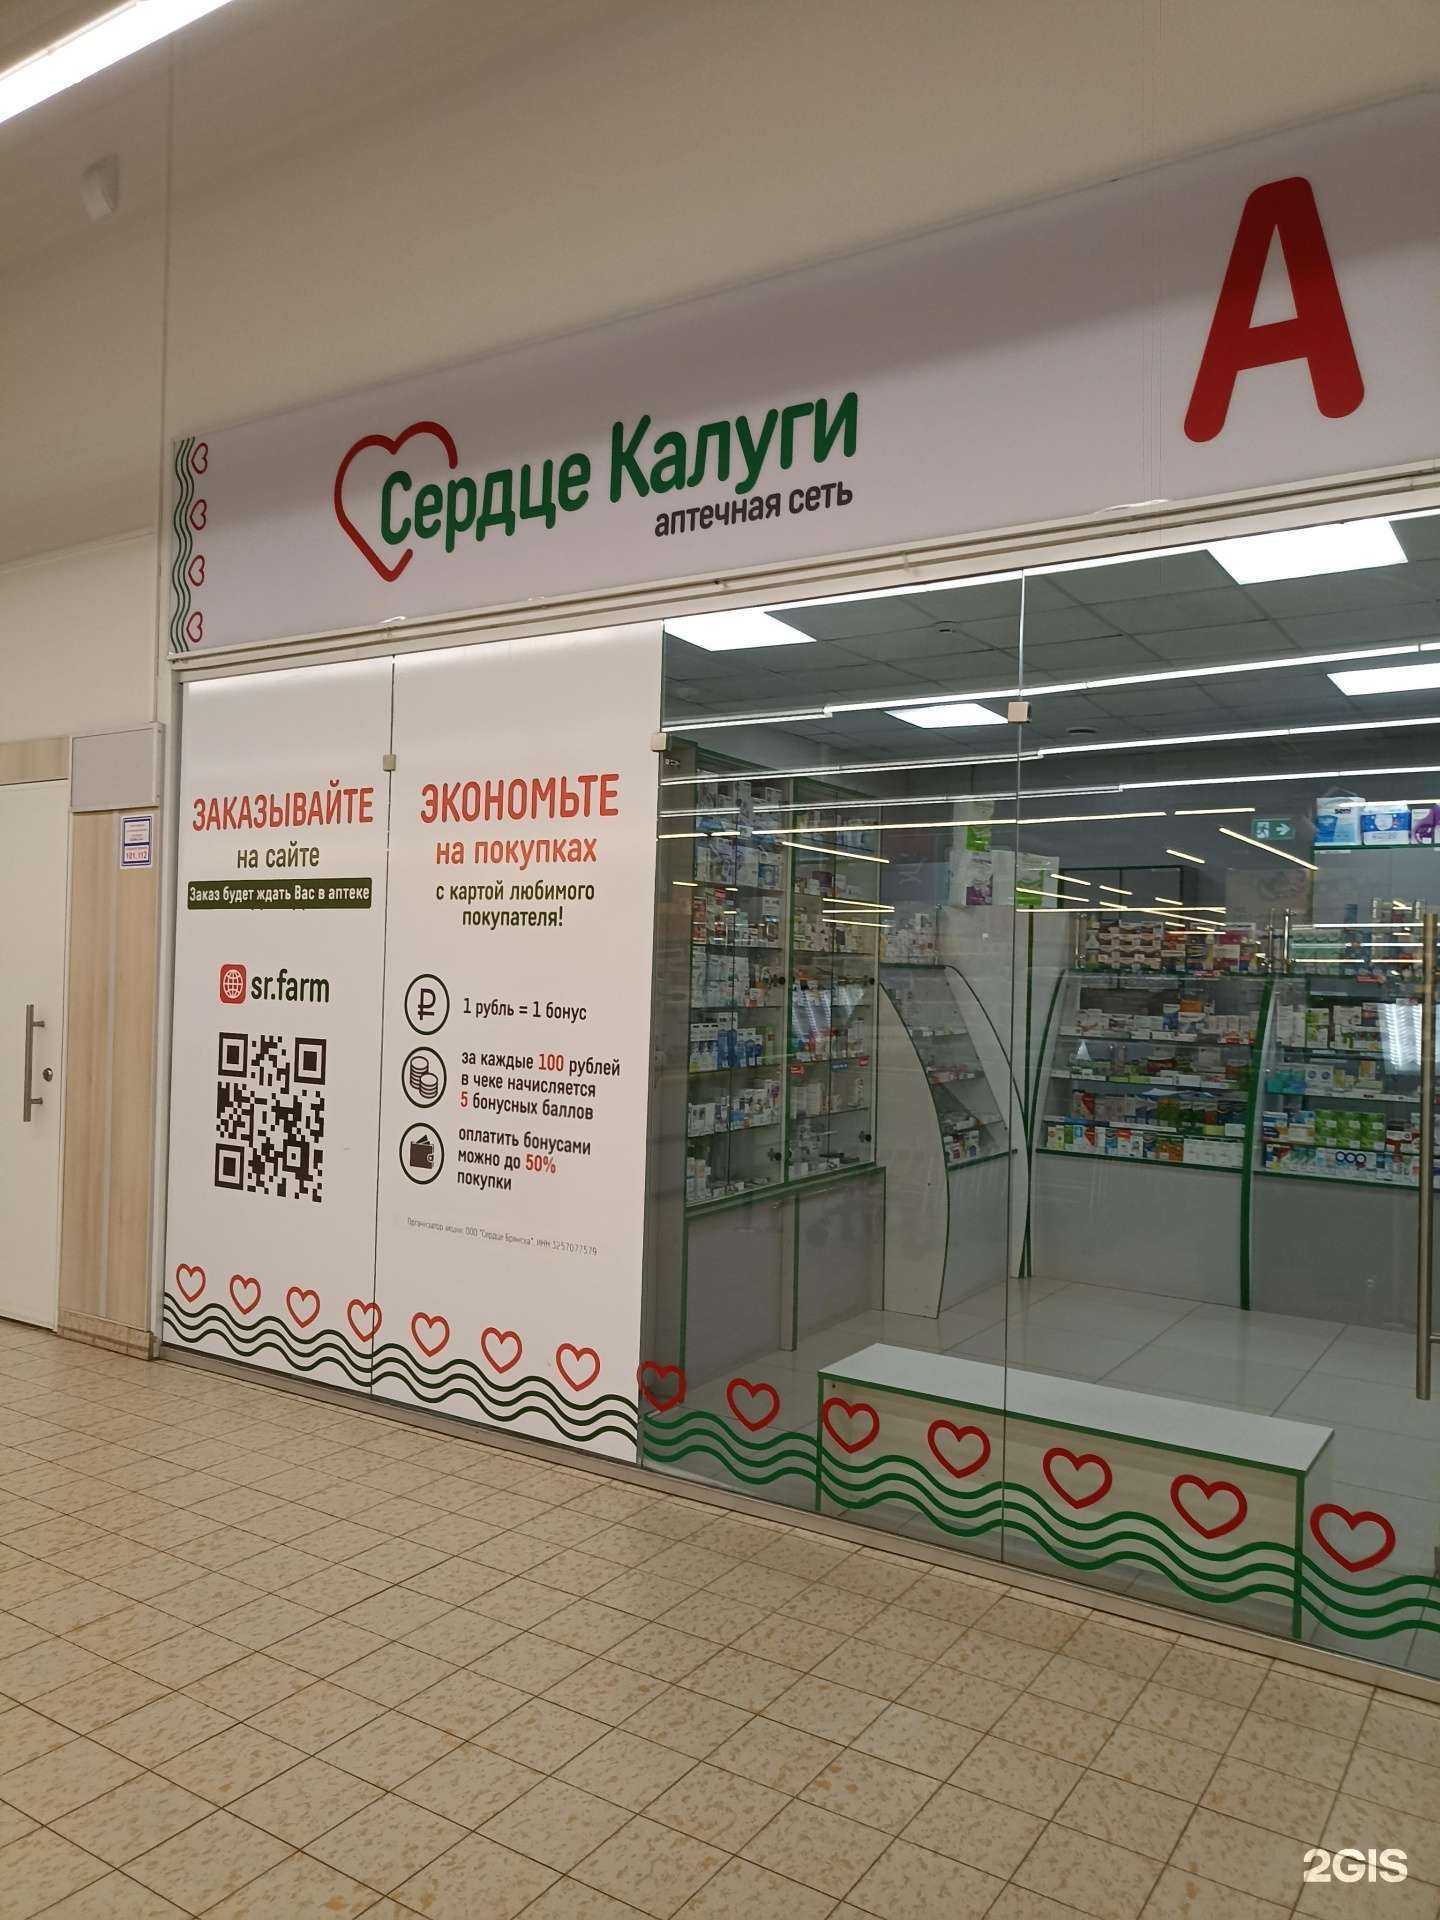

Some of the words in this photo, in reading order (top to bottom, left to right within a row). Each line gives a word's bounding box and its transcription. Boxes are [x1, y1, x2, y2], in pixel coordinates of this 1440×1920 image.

[381, 452, 591, 553] Сердце
[610, 392, 858, 503] Калуги
[654, 491, 781, 537] аптечная
[788, 480, 853, 512] сеть
[192, 779, 374, 832] ЗАКАЗЫВАЙТЕ
[420, 773, 620, 824] ЭКОНОМЬТЕ
[237, 849, 258, 869] на
[265, 840, 320, 868] сайте
[436, 841, 465, 865] на
[474, 838, 598, 871] покупках
[190, 886, 220, 901] Заказ
[222, 886, 254, 903] будет
[256, 888, 291, 902] ждать
[294, 884, 315, 900] Вас
[318, 887, 325, 899] в
[328, 887, 370, 900] аптеке
[436, 885, 445, 900] с
[449, 880, 504, 904] картой
[509, 879, 595, 900] любимого
[461, 905, 564, 931] покупателя!
[250, 968, 330, 1003] sr.farm
[463, 998, 471, 1014] 1
[475, 999, 514, 1018] рубль
[532, 1001, 541, 1018] 1
[546, 1002, 587, 1023] бонус
[461, 1052, 476, 1065] за
[480, 1053, 534, 1070] каждые
[538, 1053, 564, 1072] 100
[569, 1057, 621, 1077] рублей
[461, 1074, 469, 1086] в
[473, 1076, 503, 1089] чеке
[507, 1080, 596, 1098] начисляется
[460, 1091, 468, 1108] 5
[473, 1092, 538, 1115] бонусных
[542, 1099, 594, 1120] баллов
[458, 1127, 520, 1147] оплатить
[523, 1131, 592, 1155] бонусами
[457, 1149, 500, 1167] можно
[504, 1158, 521, 1171] до
[525, 1153, 557, 1174] 50%
[457, 1171, 512, 1191] покупки
